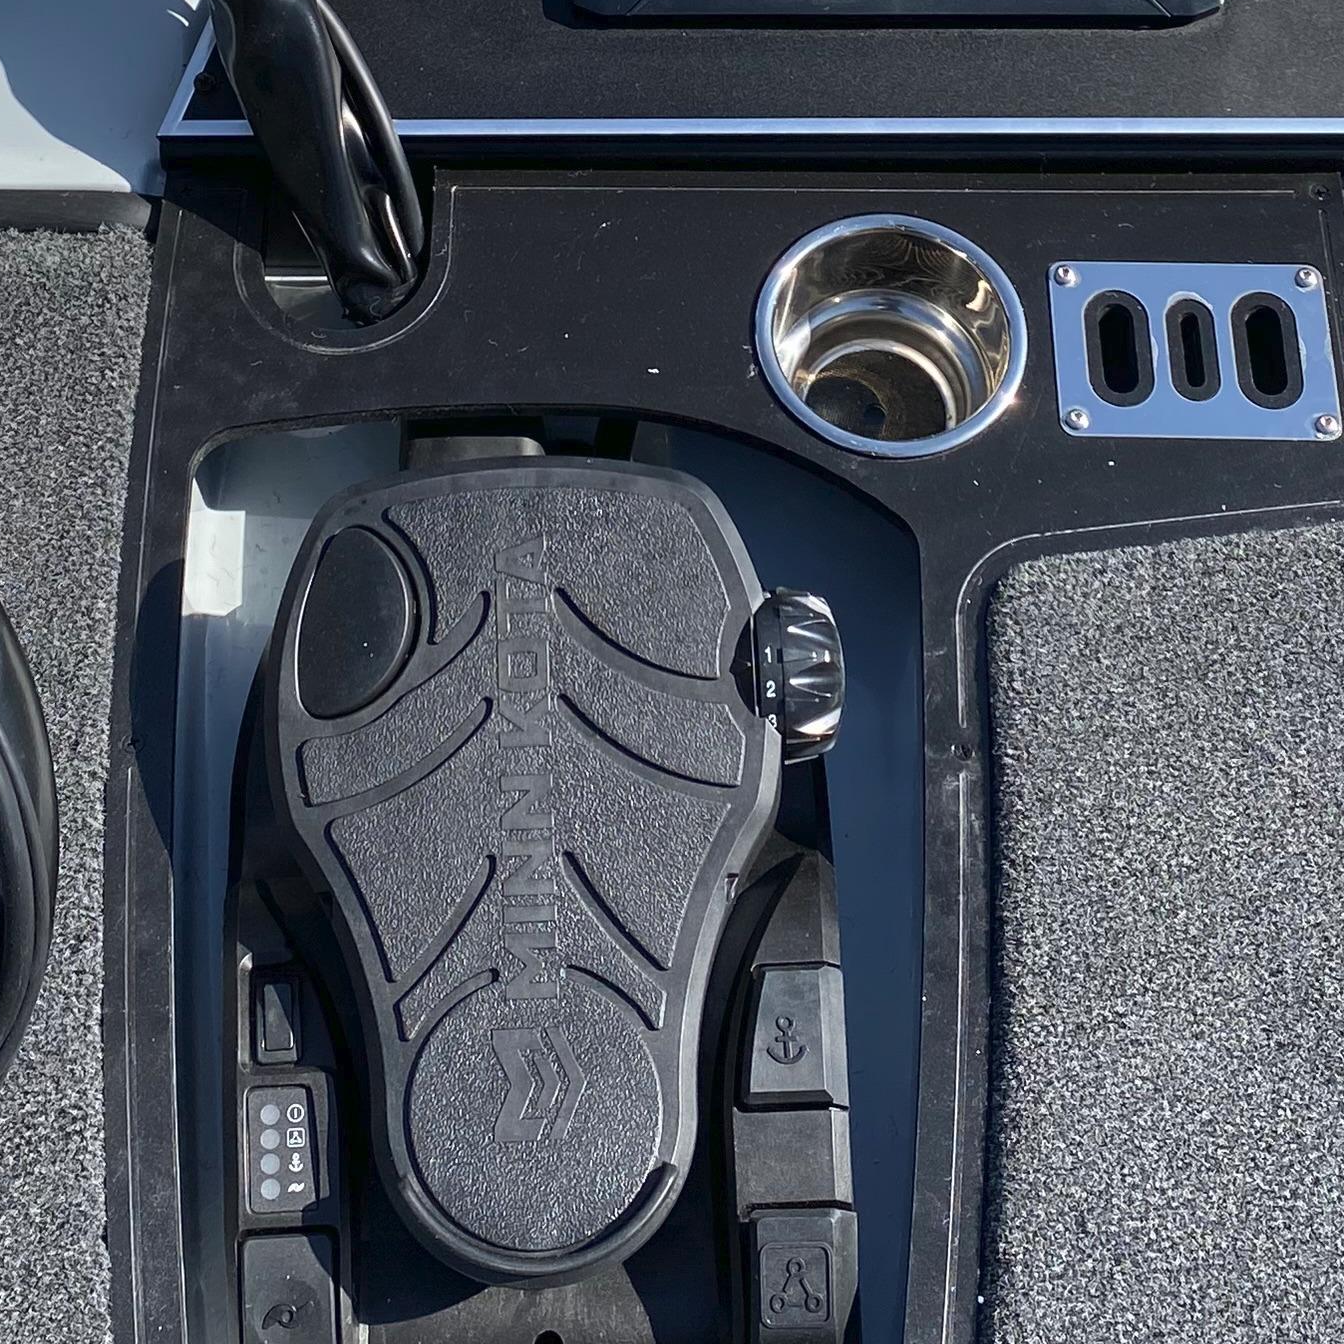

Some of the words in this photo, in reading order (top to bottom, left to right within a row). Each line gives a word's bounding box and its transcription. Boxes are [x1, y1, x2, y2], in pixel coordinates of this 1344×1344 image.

[494, 536, 552, 750] KOTA
[764, 646, 772, 663] 1
[766, 680, 776, 698] 2
[498, 775, 558, 1000] MINN
